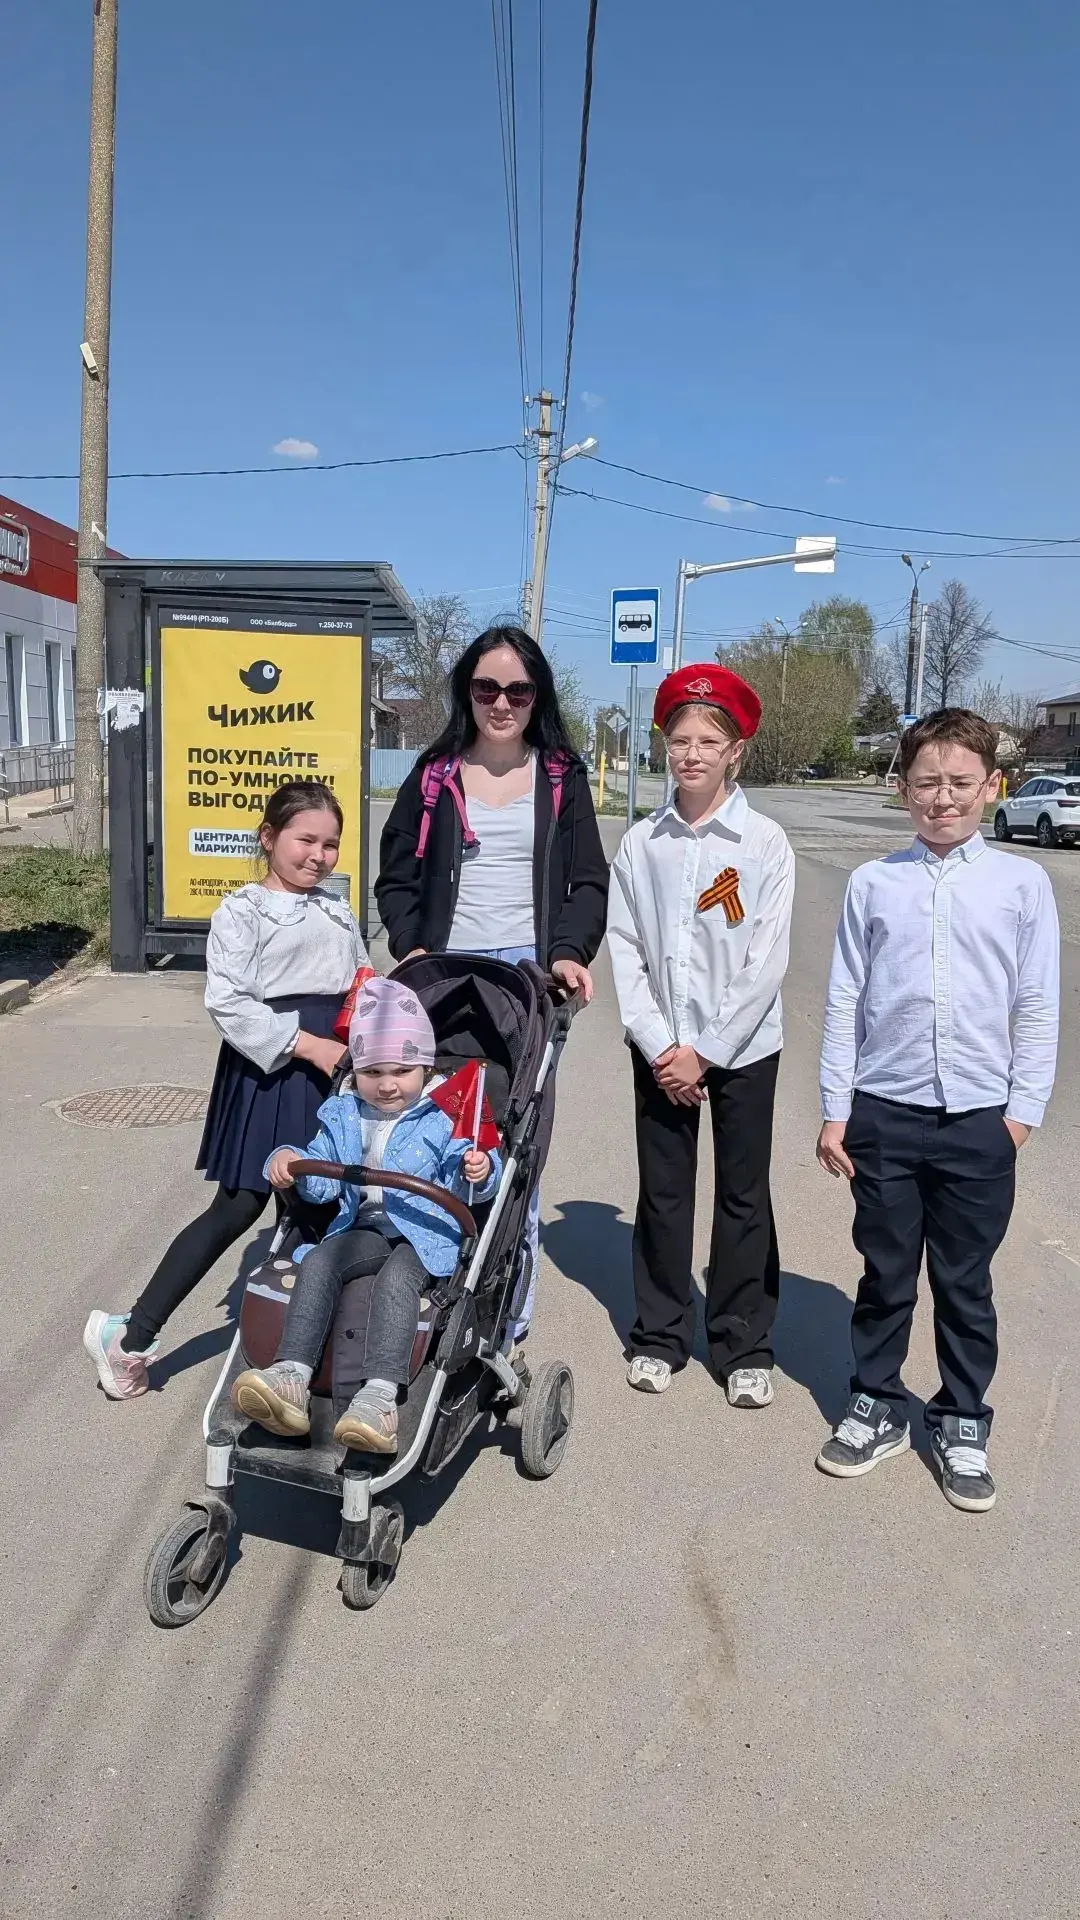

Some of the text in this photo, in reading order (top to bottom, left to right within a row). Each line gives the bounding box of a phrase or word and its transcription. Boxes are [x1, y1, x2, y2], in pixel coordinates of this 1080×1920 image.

[187, 747, 319, 768] ПОКУПАЙТЕ
[188, 791, 271, 812] ВЫГОД
[194, 831, 260, 844] ЦЕНТРАЛЬ
